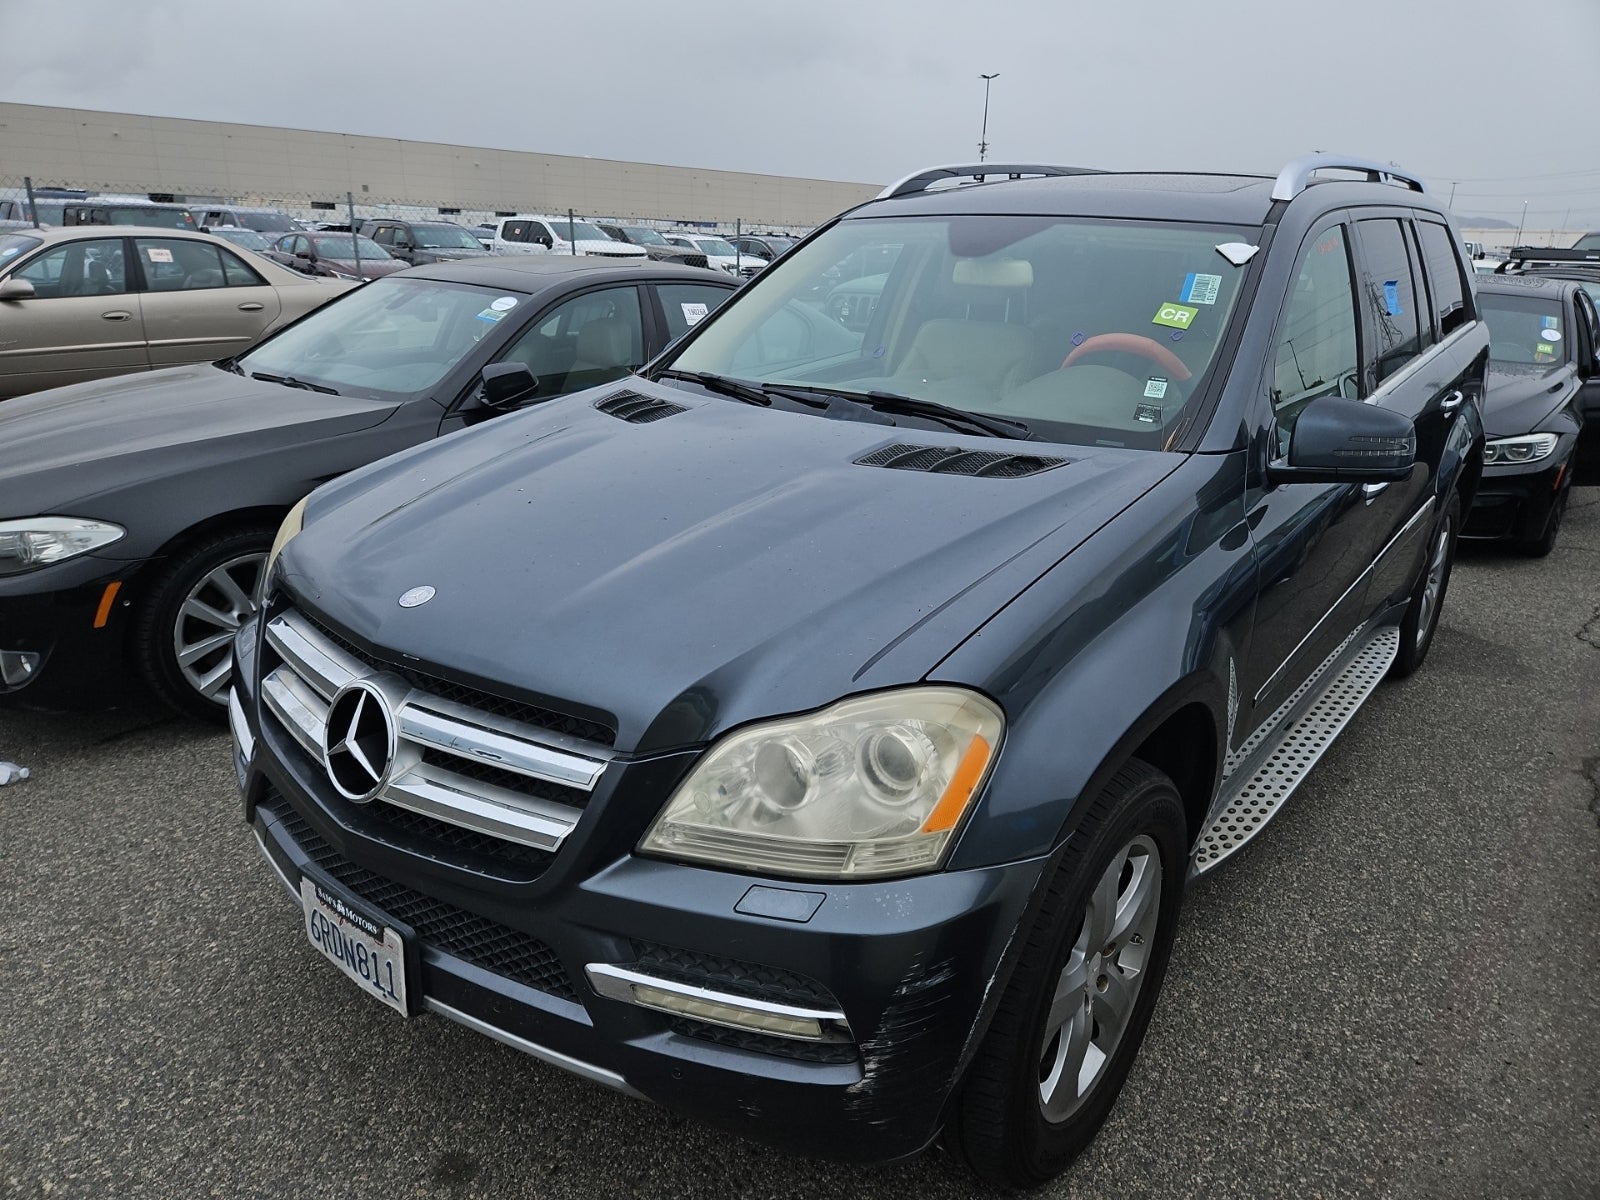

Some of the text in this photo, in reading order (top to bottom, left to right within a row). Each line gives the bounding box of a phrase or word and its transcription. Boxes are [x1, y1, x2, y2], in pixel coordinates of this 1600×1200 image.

[1161, 308, 1190, 323] CR
[345, 907, 377, 935] MOTORS
[310, 908, 400, 1002] 6RDN811
